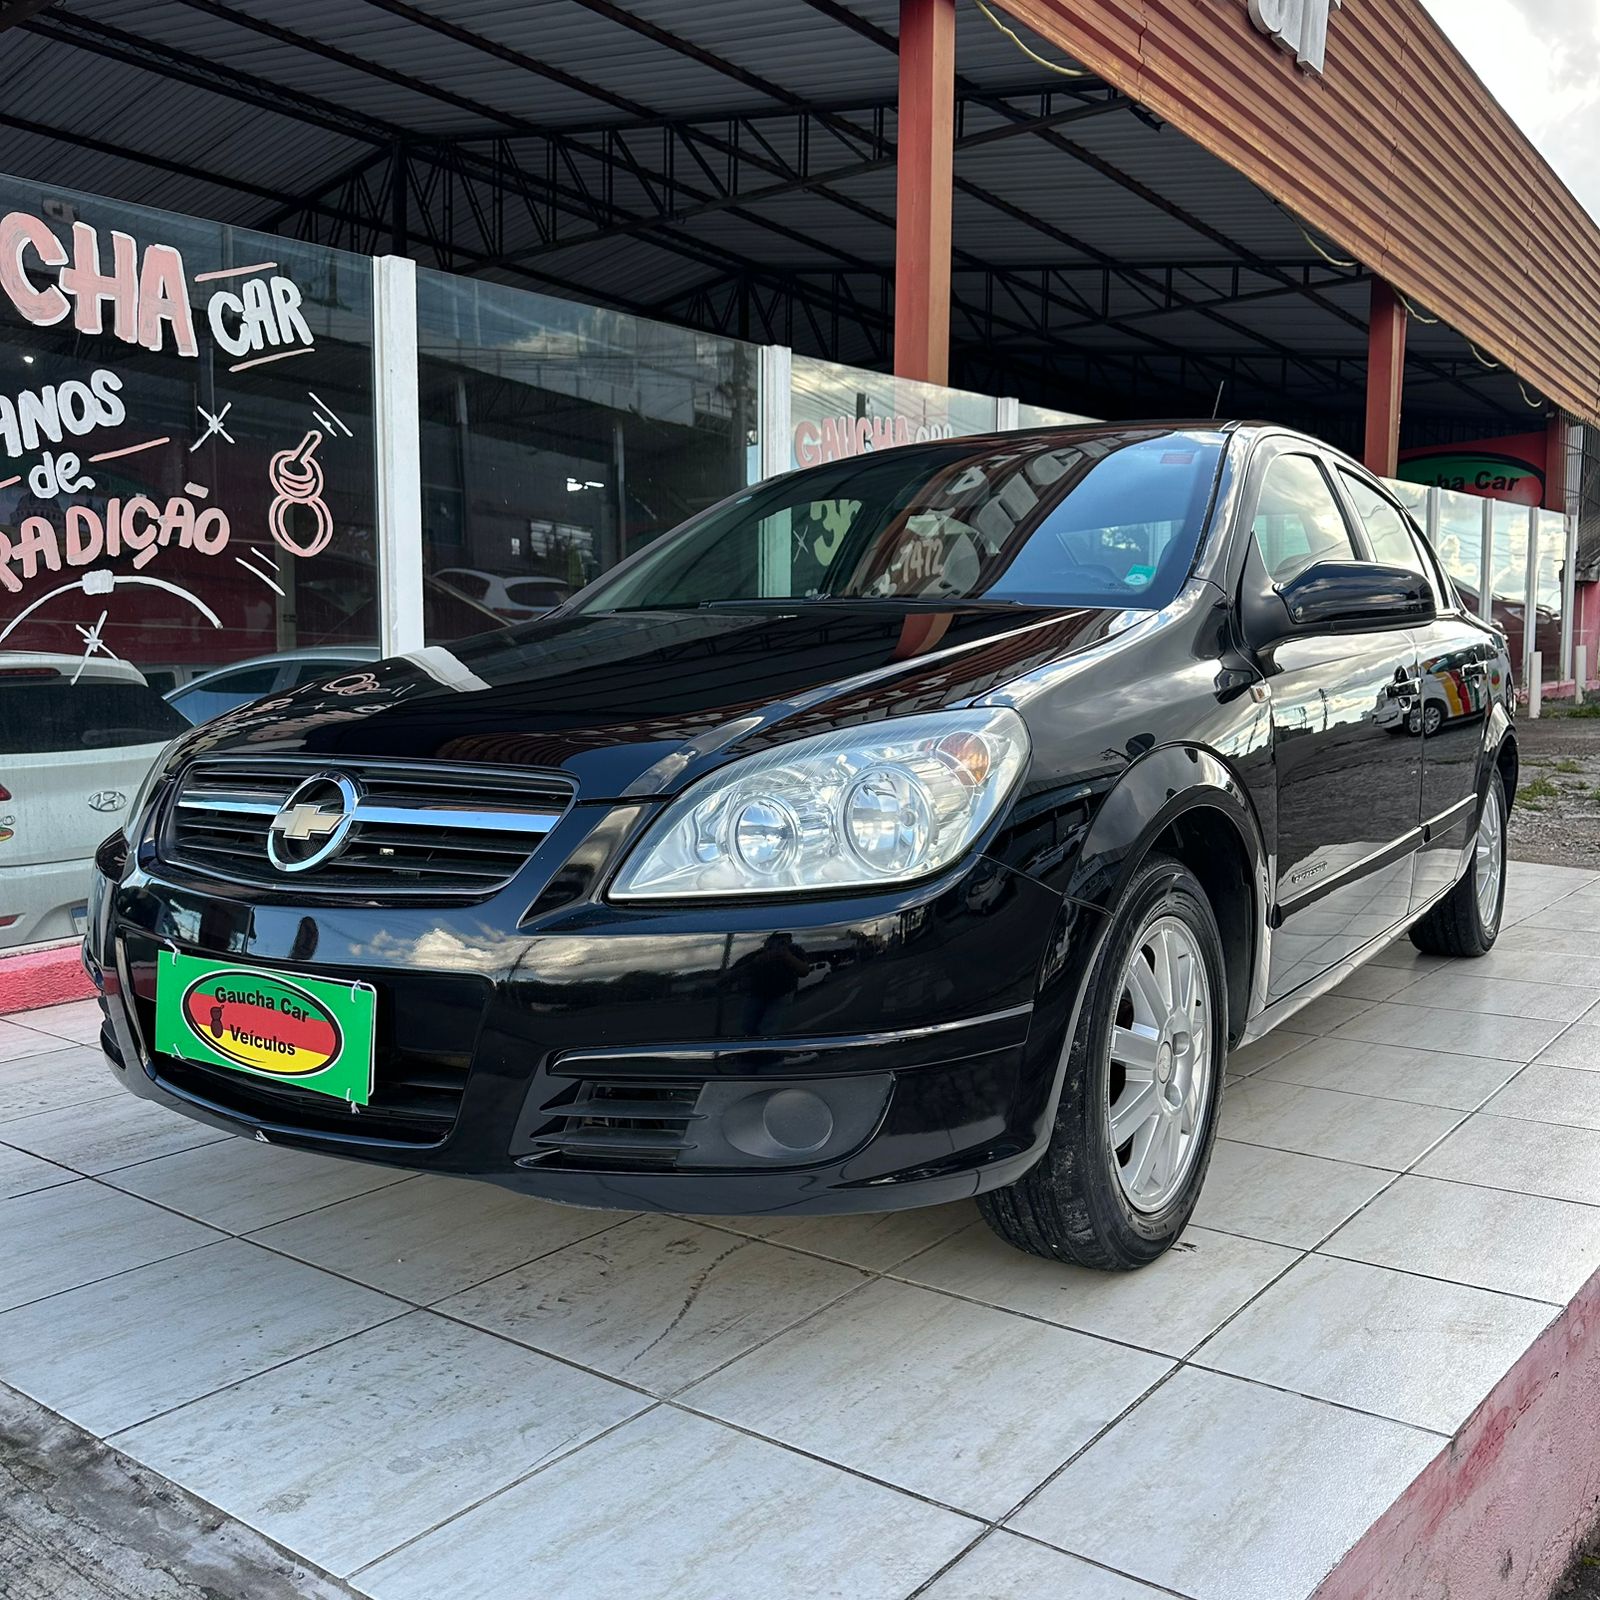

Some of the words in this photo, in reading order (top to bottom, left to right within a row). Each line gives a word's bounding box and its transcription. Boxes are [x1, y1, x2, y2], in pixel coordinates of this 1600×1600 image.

[207, 275, 315, 357] CAR
[28, 451, 96, 499] de
[1475, 470, 1520, 491] Car
[215, 986, 275, 1011] Gaucha
[280, 997, 310, 1023] Car
[229, 1024, 296, 1056] Veículos
